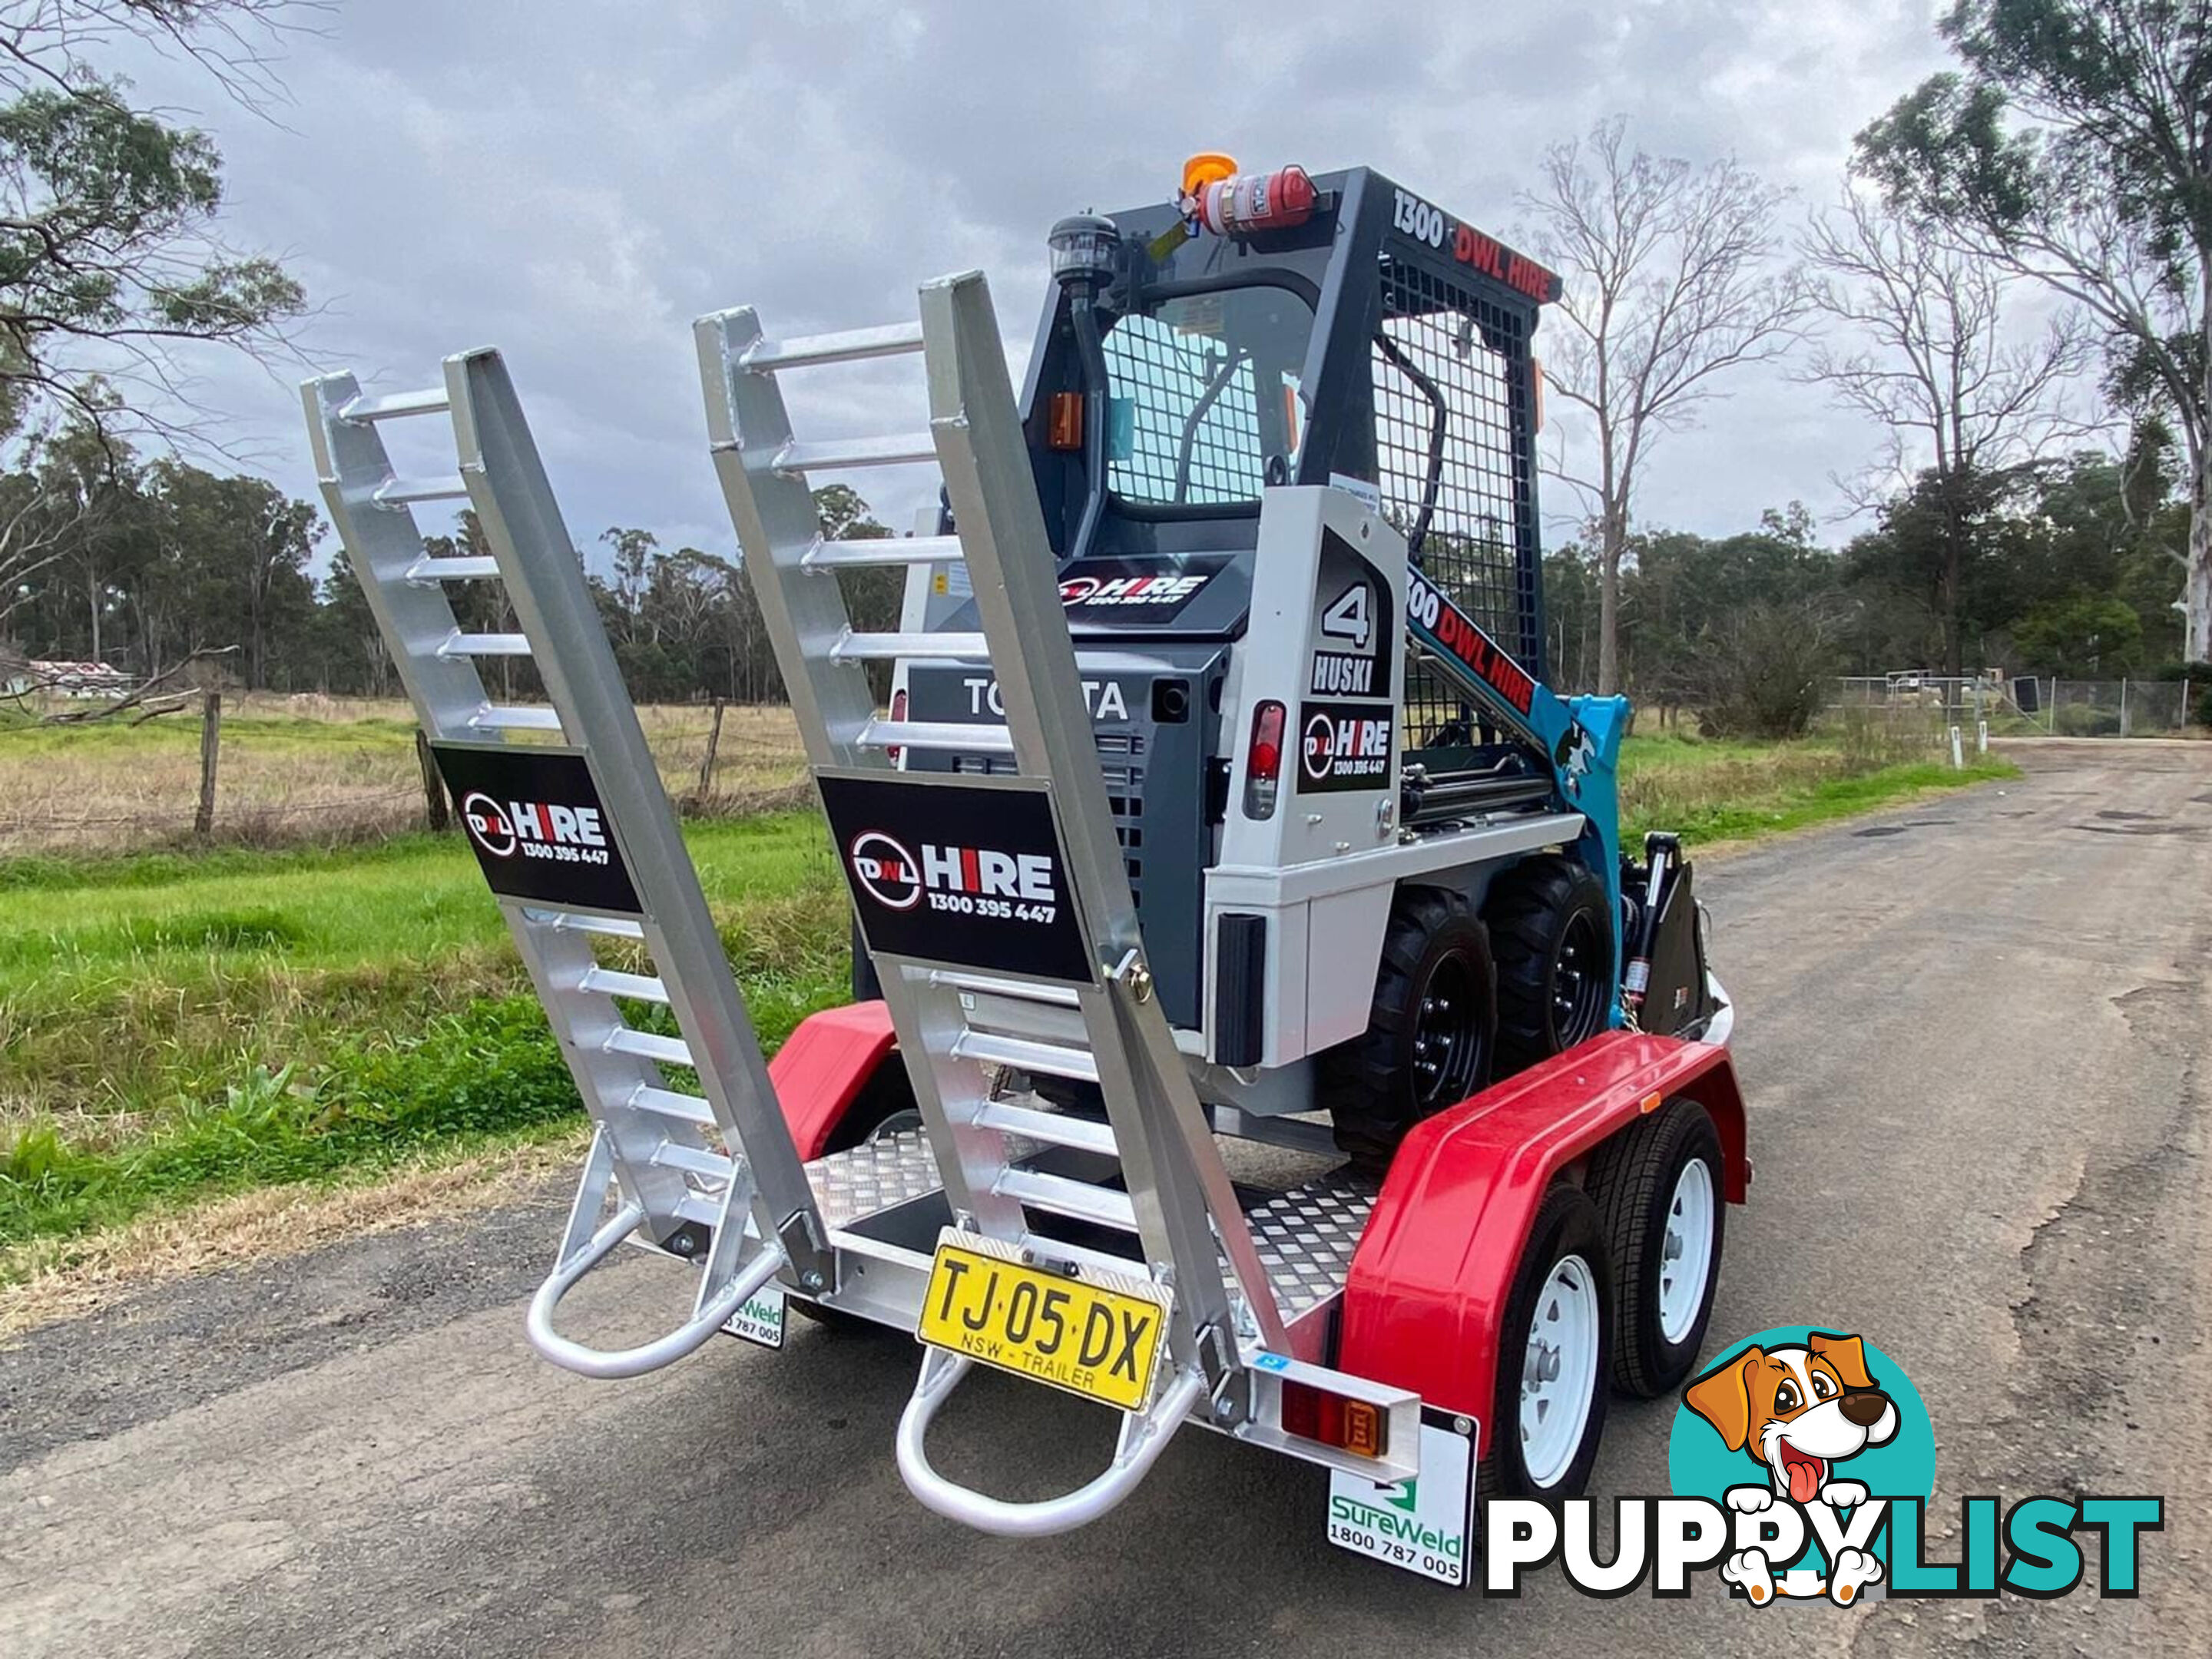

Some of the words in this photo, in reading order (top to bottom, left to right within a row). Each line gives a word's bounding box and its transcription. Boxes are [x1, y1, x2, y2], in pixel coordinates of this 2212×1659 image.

[1394, 187, 1444, 248] 1300
[1454, 221, 1503, 280] DWL
[1508, 252, 1550, 303] HIRE
[1095, 575, 1208, 597] HIRE
[1323, 584, 1369, 645] 4
[1313, 655, 1373, 693] HUSKI
[1437, 604, 1487, 674] DWL
[1488, 653, 1534, 716] HIRE
[1335, 720, 1390, 757] HIRE
[509, 801, 607, 847] HIRE
[521, 842, 554, 859] 1300
[552, 846, 580, 863] 395
[581, 849, 609, 866] 447
[922, 844, 1056, 902] HIRE
[928, 892, 974, 914] 1300
[975, 898, 1012, 919] 395
[1015, 903, 1056, 924] 447
[736, 1317, 757, 1334] 787
[758, 1325, 780, 1343] 005
[960, 1333, 1002, 1359] NSW
[1022, 1350, 1096, 1390] TRAILER
[1330, 1524, 1376, 1551] 1800
[1382, 1540, 1417, 1565] 787
[1422, 1555, 1460, 1580] 005
[1331, 1495, 1462, 1559] SureWeld
